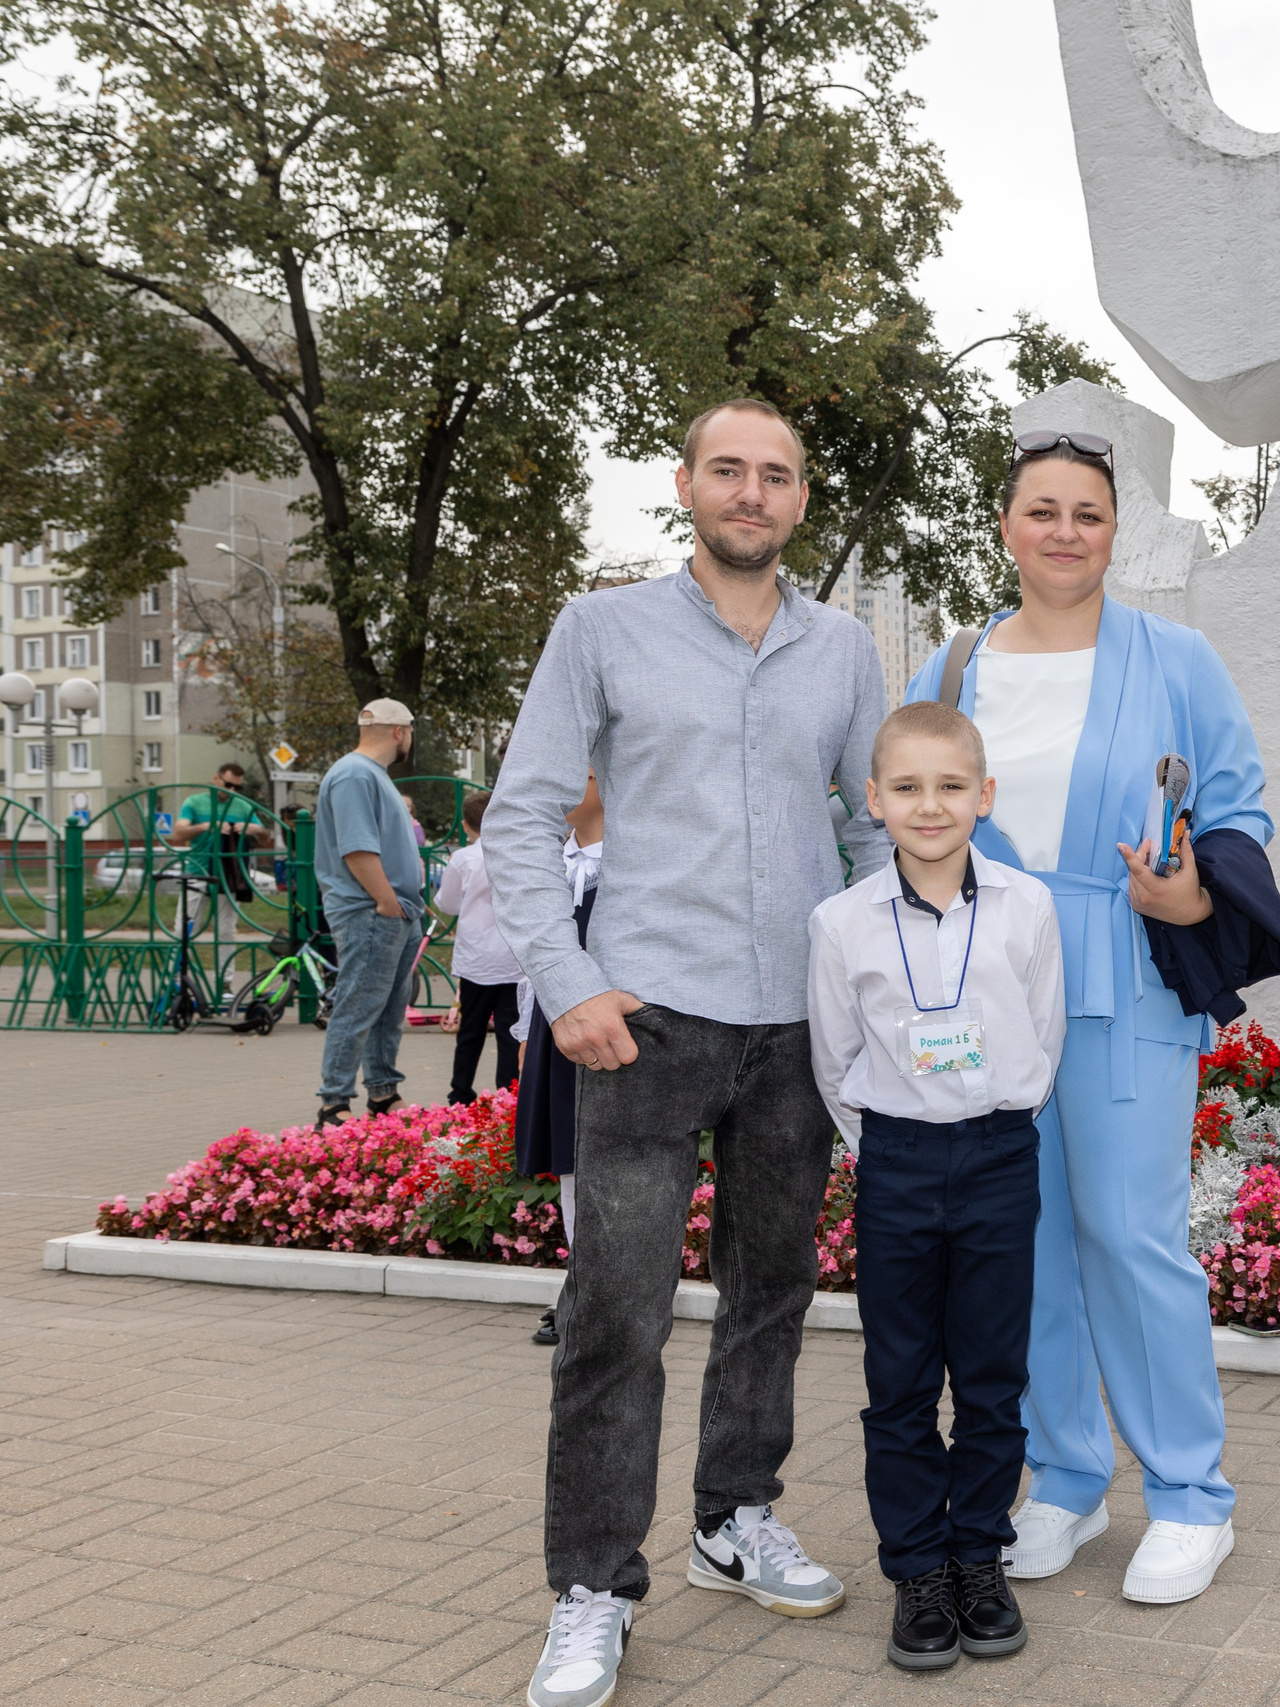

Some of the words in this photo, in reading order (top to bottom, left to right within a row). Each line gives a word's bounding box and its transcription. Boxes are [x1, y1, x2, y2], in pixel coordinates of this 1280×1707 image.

[920, 1037, 953, 1048] Роман
[955, 1034, 961, 1044] 1
[963, 1033, 970, 1043] Б
